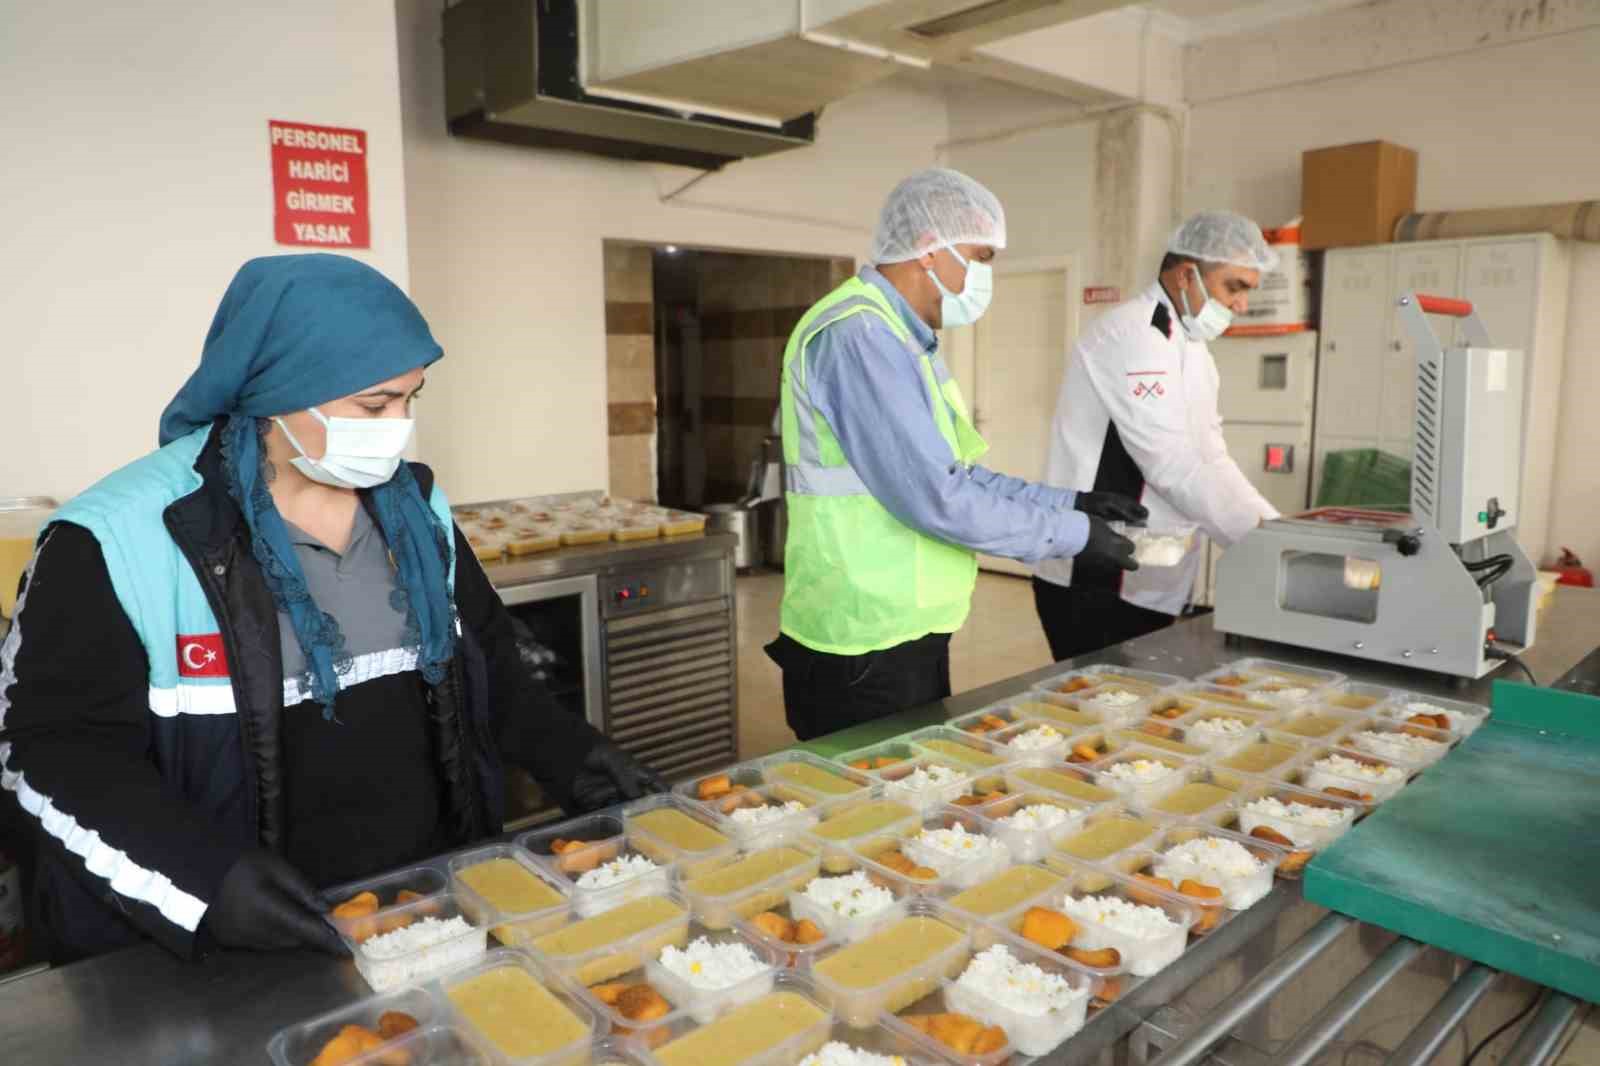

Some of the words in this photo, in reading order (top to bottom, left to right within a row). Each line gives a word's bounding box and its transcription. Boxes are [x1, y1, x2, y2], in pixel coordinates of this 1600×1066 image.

[271, 127, 363, 154] PERSONEL
[289, 160, 349, 182] HARİCİ
[286, 188, 355, 214] GİRMEK
[293, 223, 352, 244] YASAK
